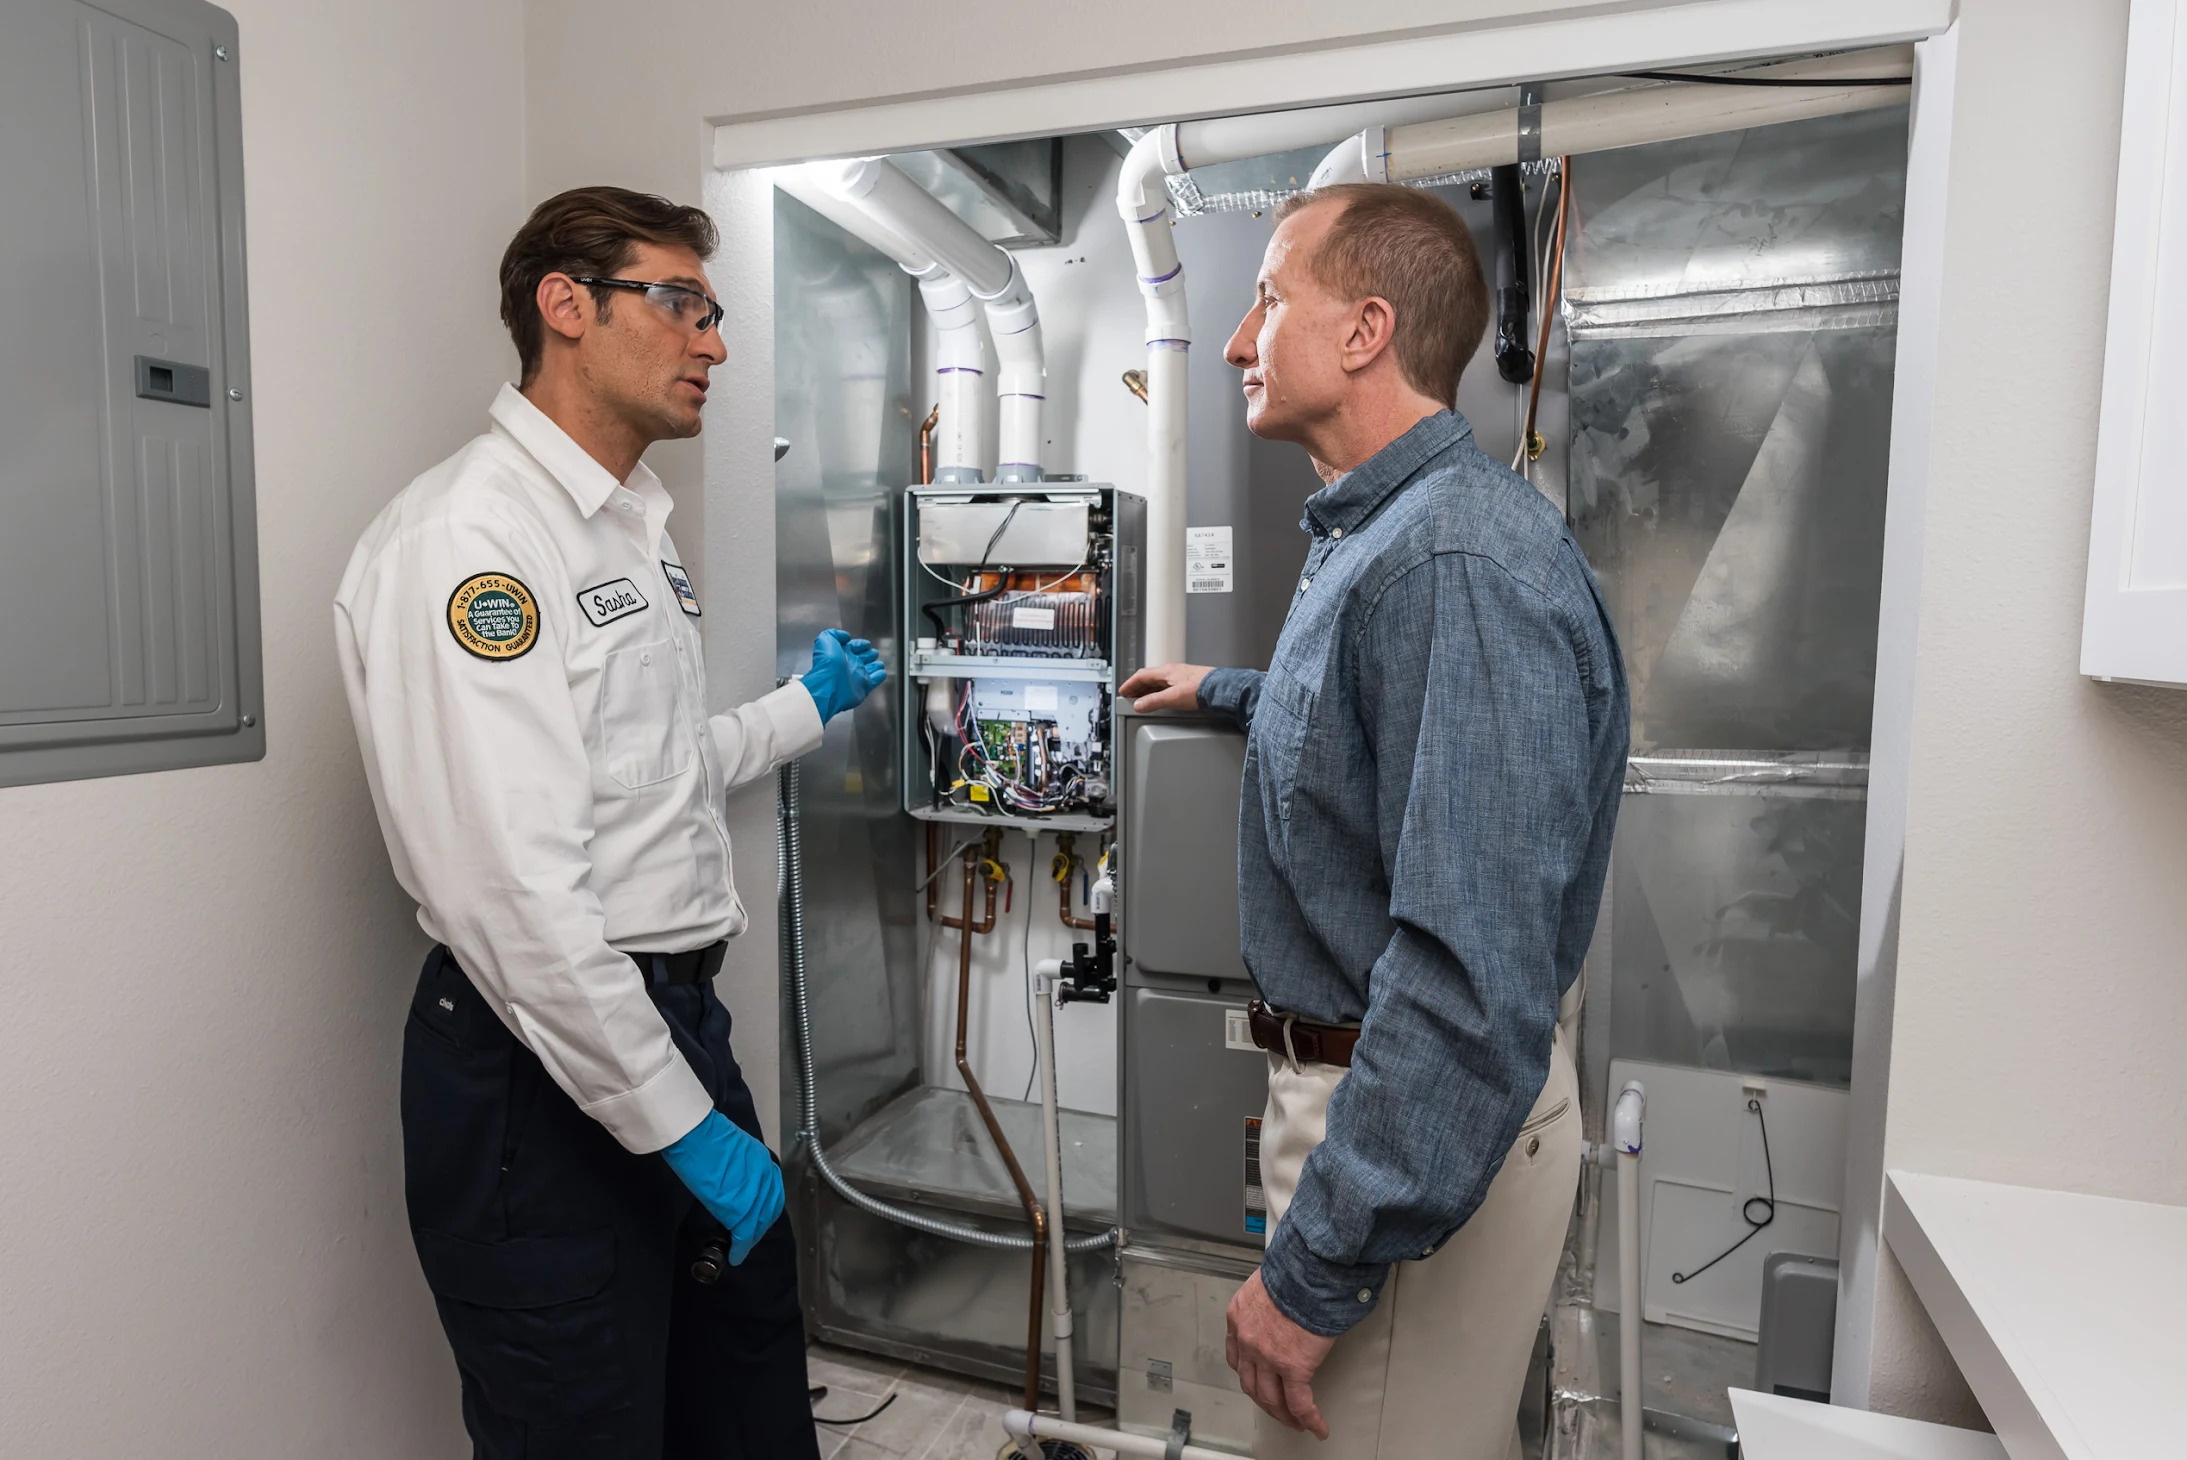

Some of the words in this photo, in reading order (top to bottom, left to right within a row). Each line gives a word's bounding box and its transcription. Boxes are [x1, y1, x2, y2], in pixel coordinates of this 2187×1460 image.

[457, 579, 527, 609] 1-877-655-UWIN
[593, 590, 637, 616] Sasha
[473, 616, 506, 625] Services
[474, 609, 513, 617] Guarantee
[457, 618, 501, 652] SATISFACTION
[505, 614, 533, 651] GUARANTEED
